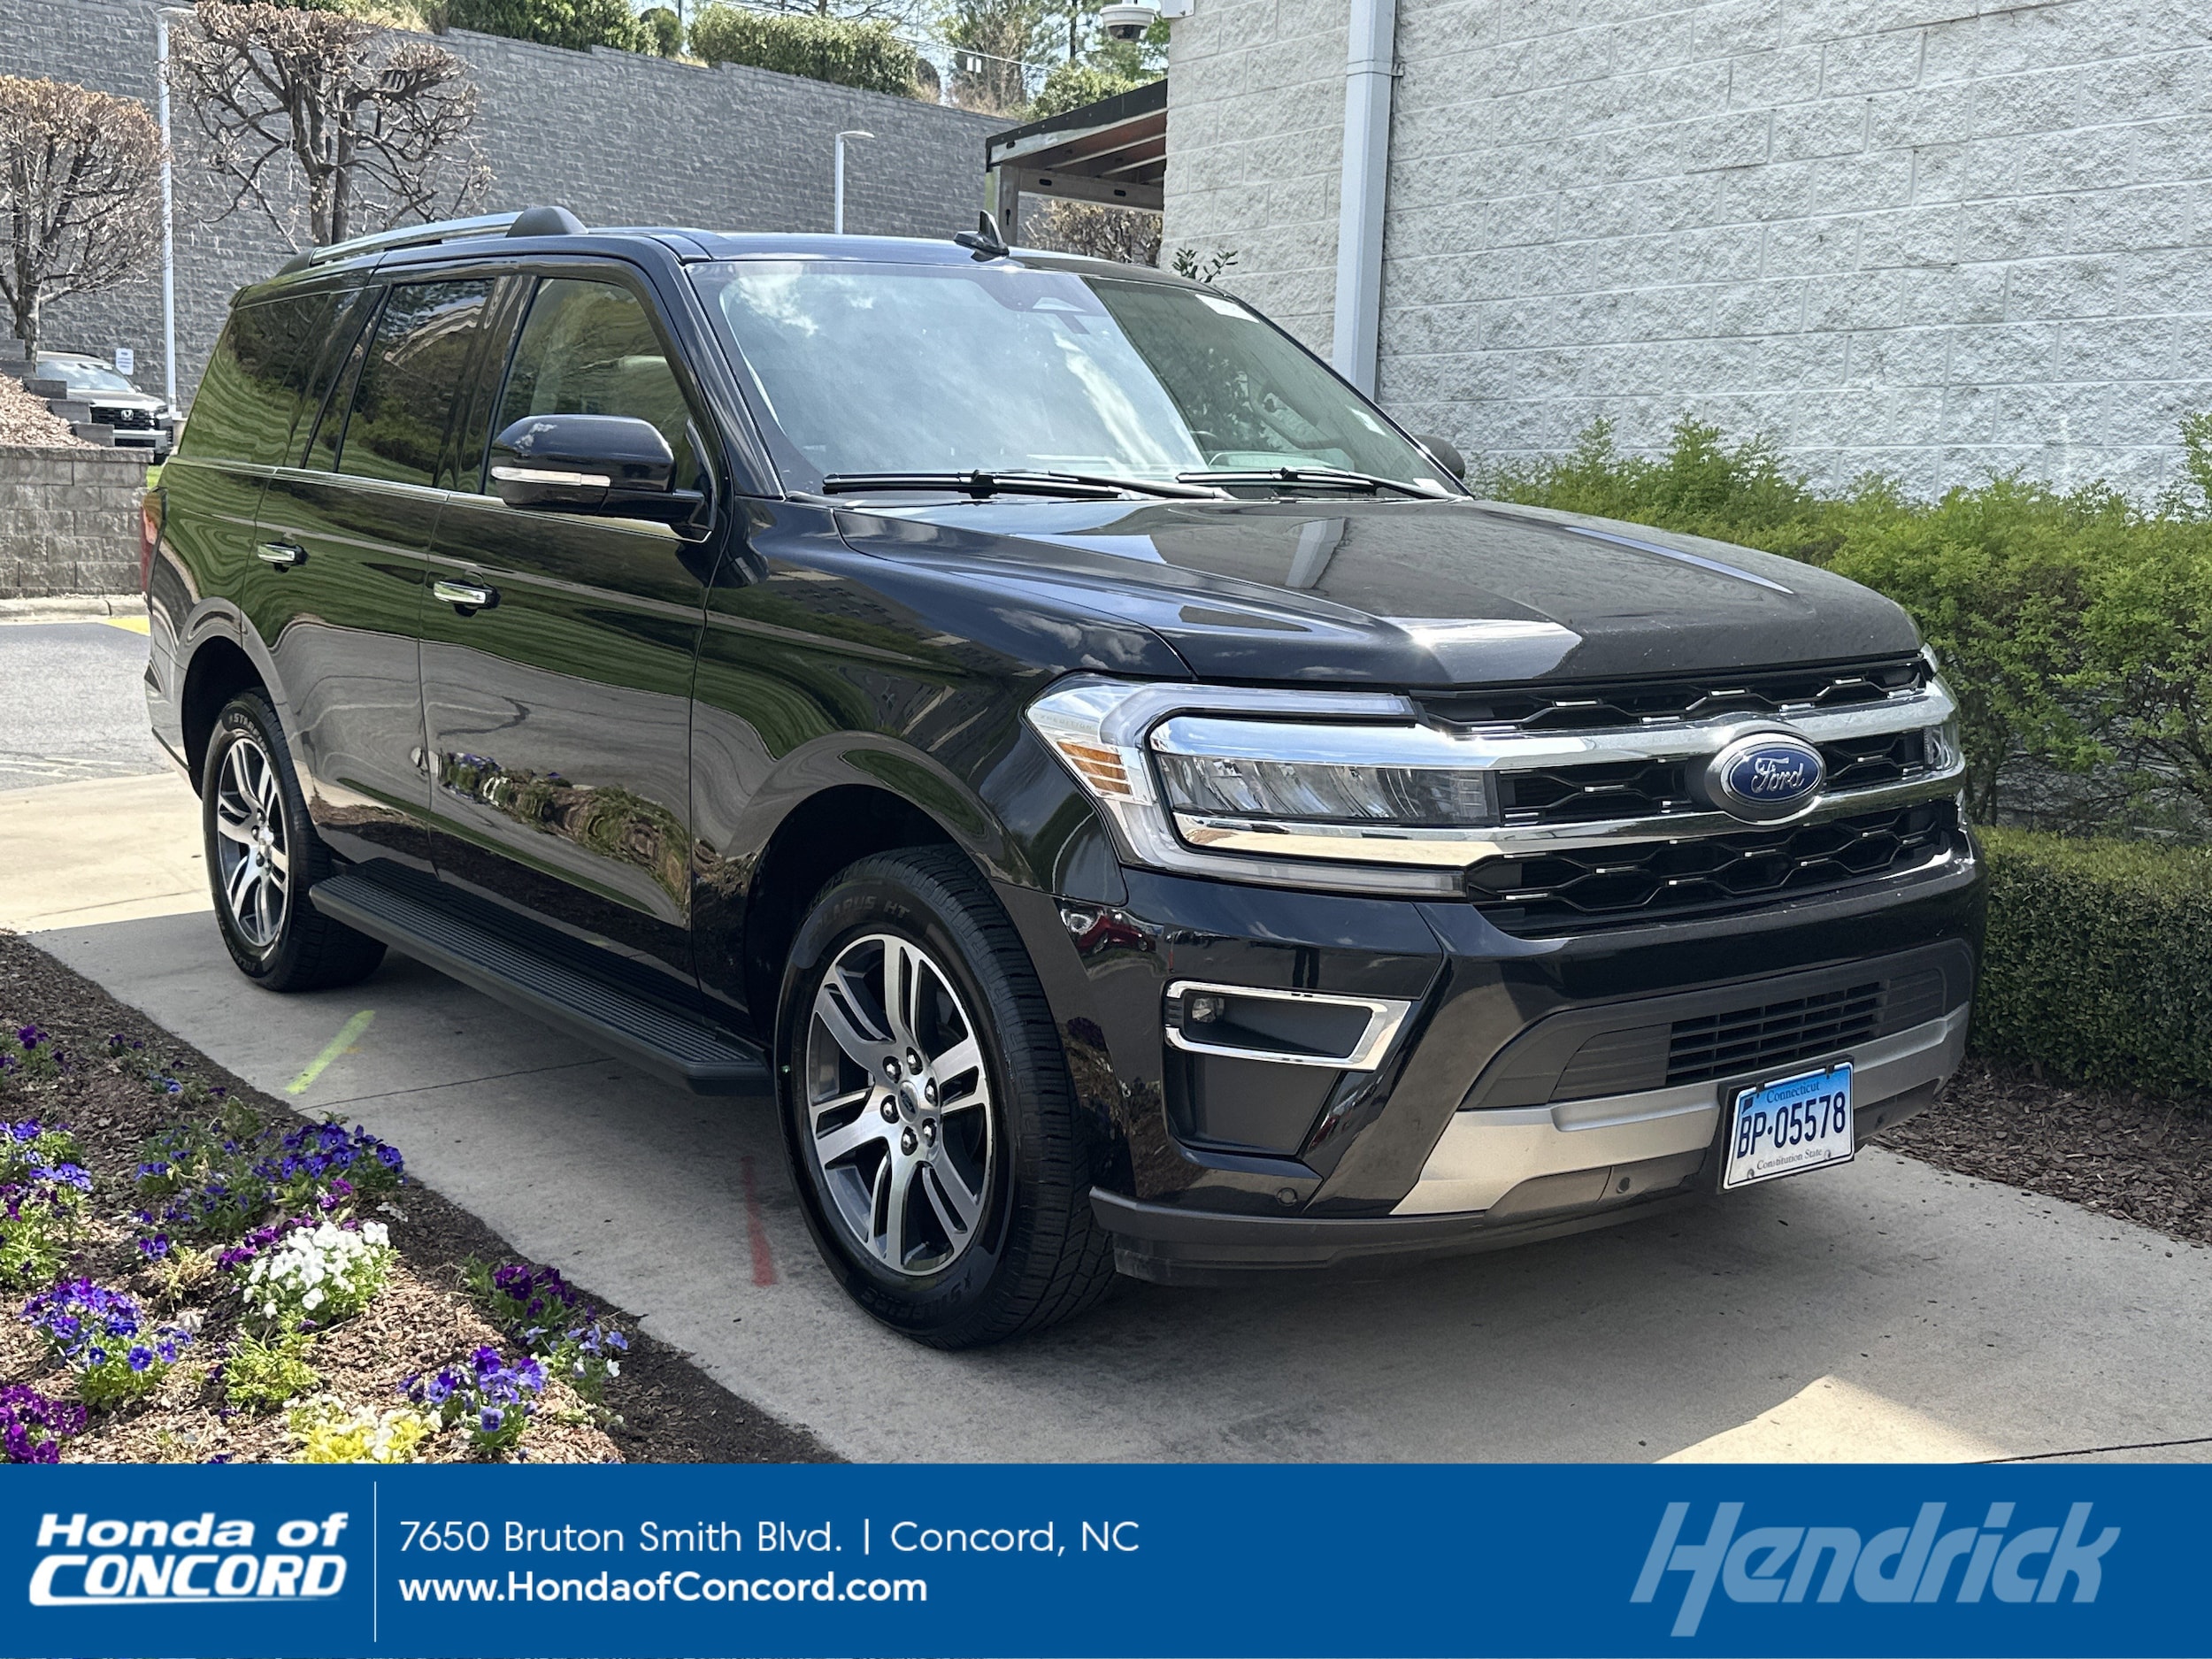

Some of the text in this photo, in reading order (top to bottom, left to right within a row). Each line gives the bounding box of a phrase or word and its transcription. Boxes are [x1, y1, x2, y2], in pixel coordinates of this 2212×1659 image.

[1750, 757, 1805, 794] Ford
[1766, 1080, 1821, 1104] Connecticut
[1756, 1153, 1803, 1171] Constitution
